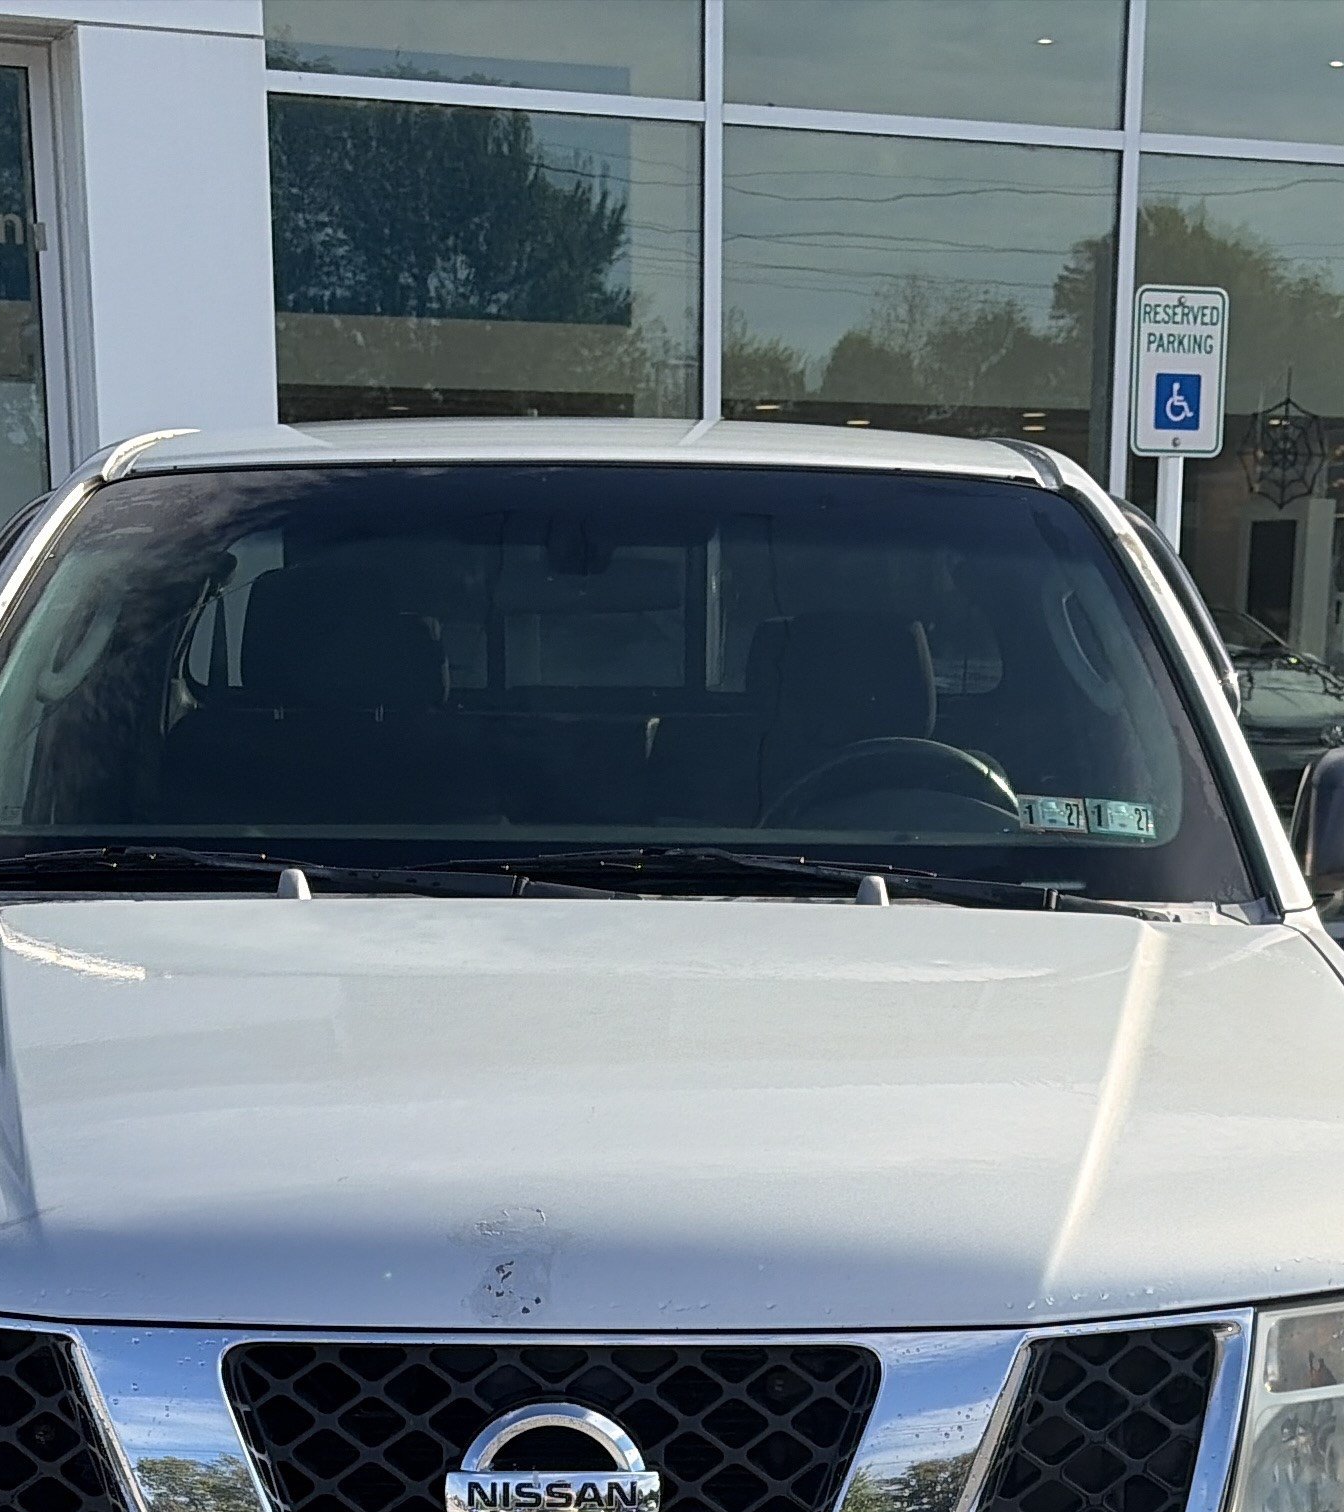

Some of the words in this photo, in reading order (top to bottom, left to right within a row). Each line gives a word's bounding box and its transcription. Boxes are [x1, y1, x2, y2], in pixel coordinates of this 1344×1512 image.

[1143, 303, 1220, 326] RESERVED
[1146, 332, 1214, 354] PARKING
[1064, 802, 1080, 828] 27
[1094, 804, 1103, 827] 1
[1134, 808, 1150, 832] 27
[467, 1480, 639, 1508] NISSAN
